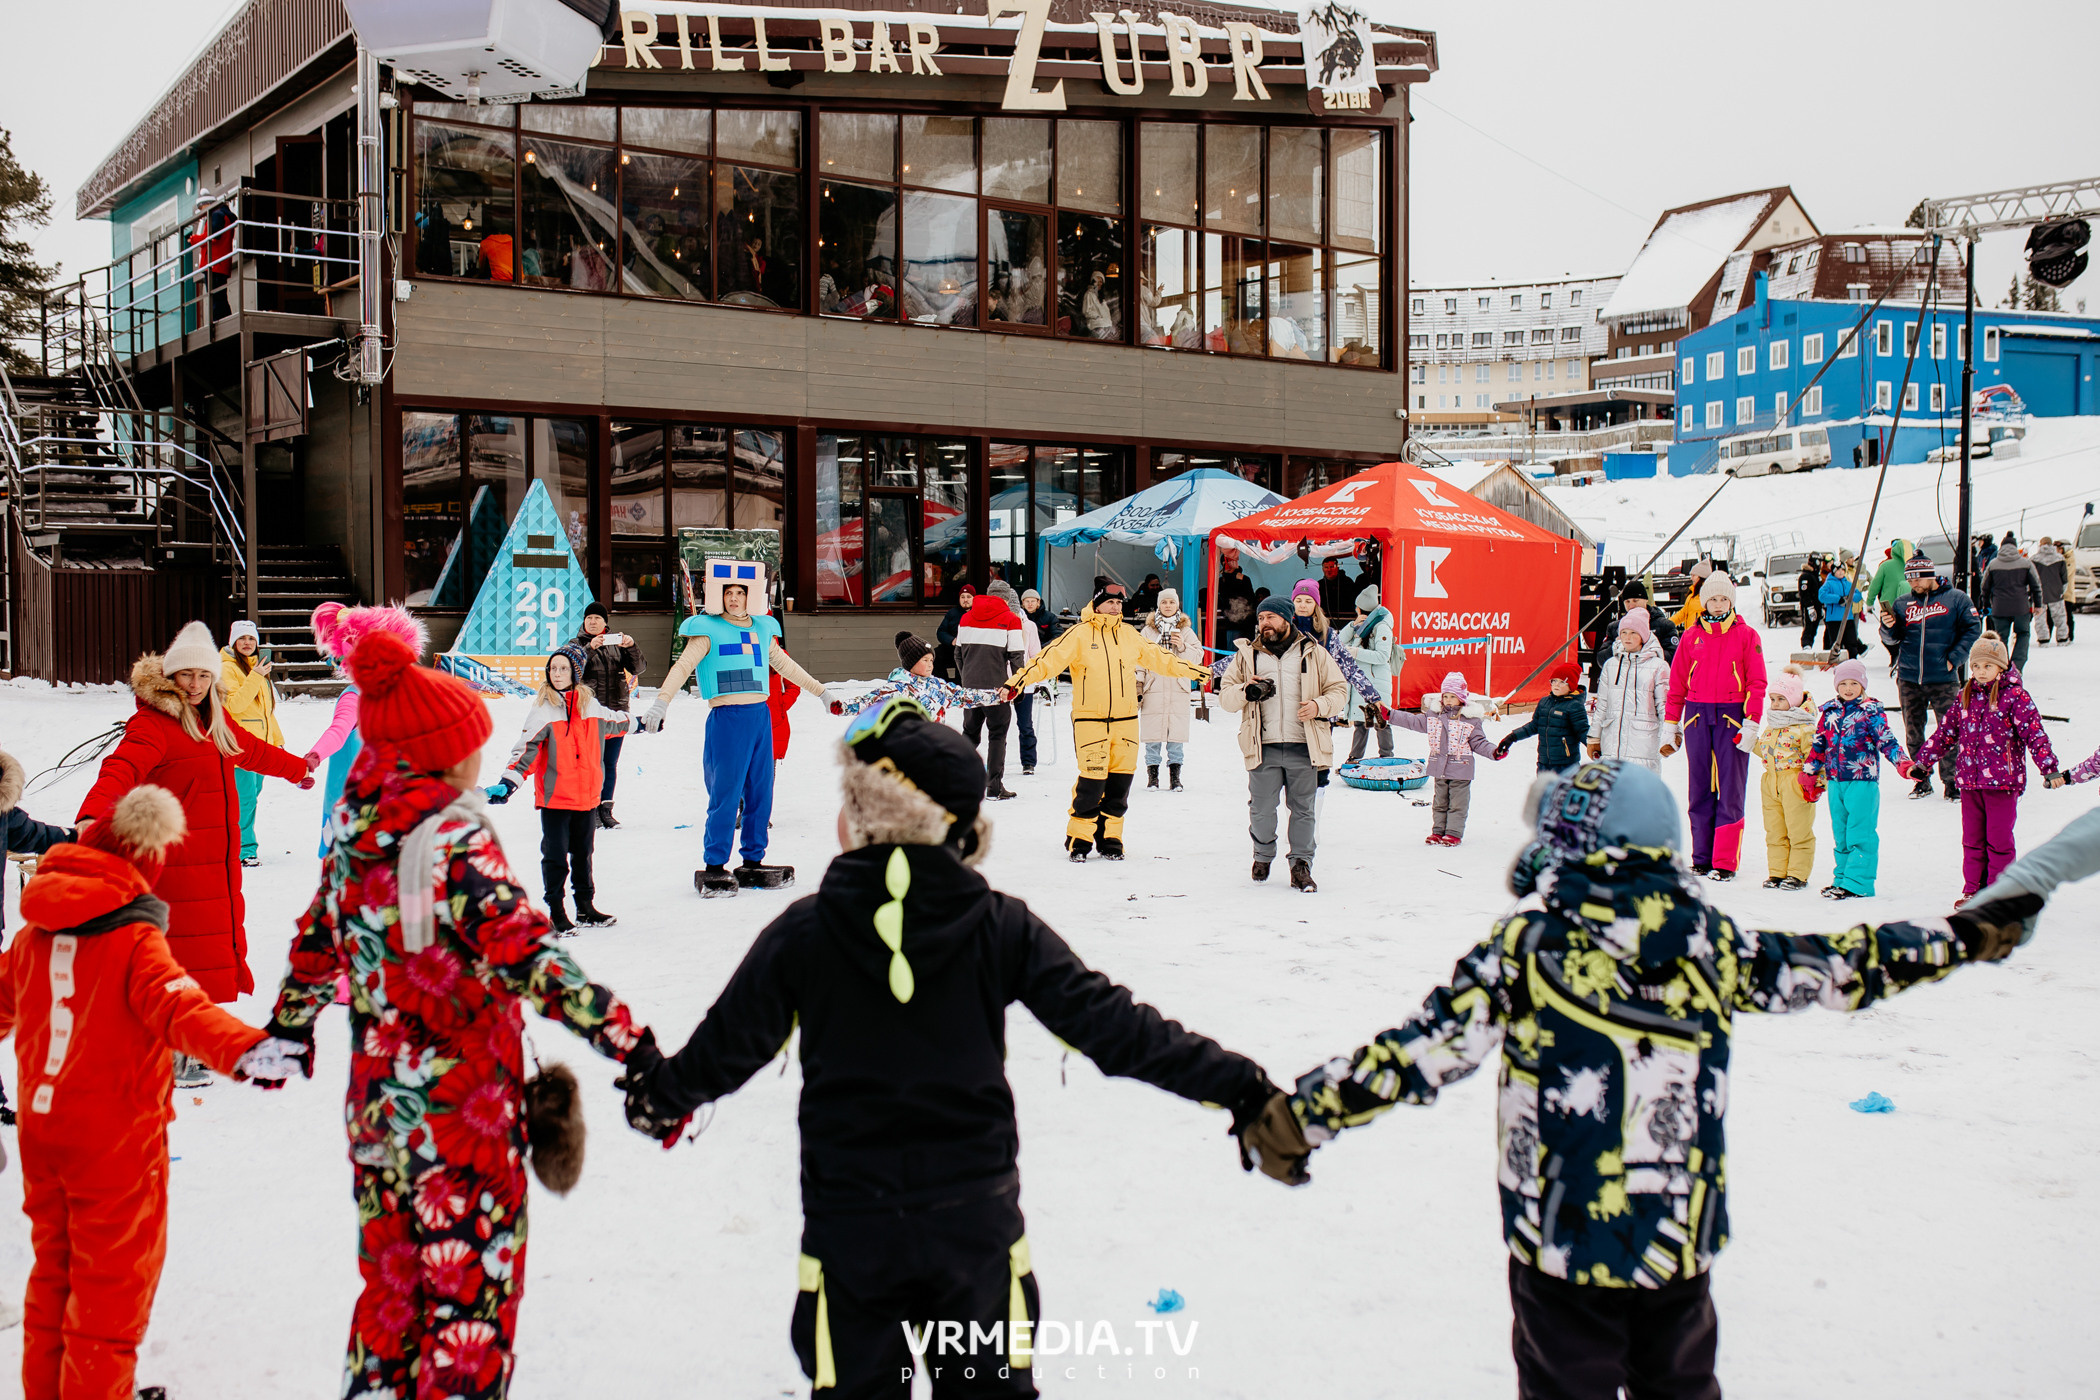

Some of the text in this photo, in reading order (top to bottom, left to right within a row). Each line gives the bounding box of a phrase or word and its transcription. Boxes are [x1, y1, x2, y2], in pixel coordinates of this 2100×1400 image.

[589, 0, 1272, 110] RILL BAR ZUBR
[1322, 89, 1371, 109] ZUBR
[1280, 506, 1372, 517] КУЗБАССКАЯ
[1413, 507, 1502, 527] КУЗБАССКАЯ
[516, 581, 565, 618] 20
[1411, 611, 1510, 630] КУЗБАССКАЯ
[1905, 602, 1948, 621] Russia
[516, 616, 561, 652] 21
[1412, 636, 1526, 658] МЕДИАГРППА
